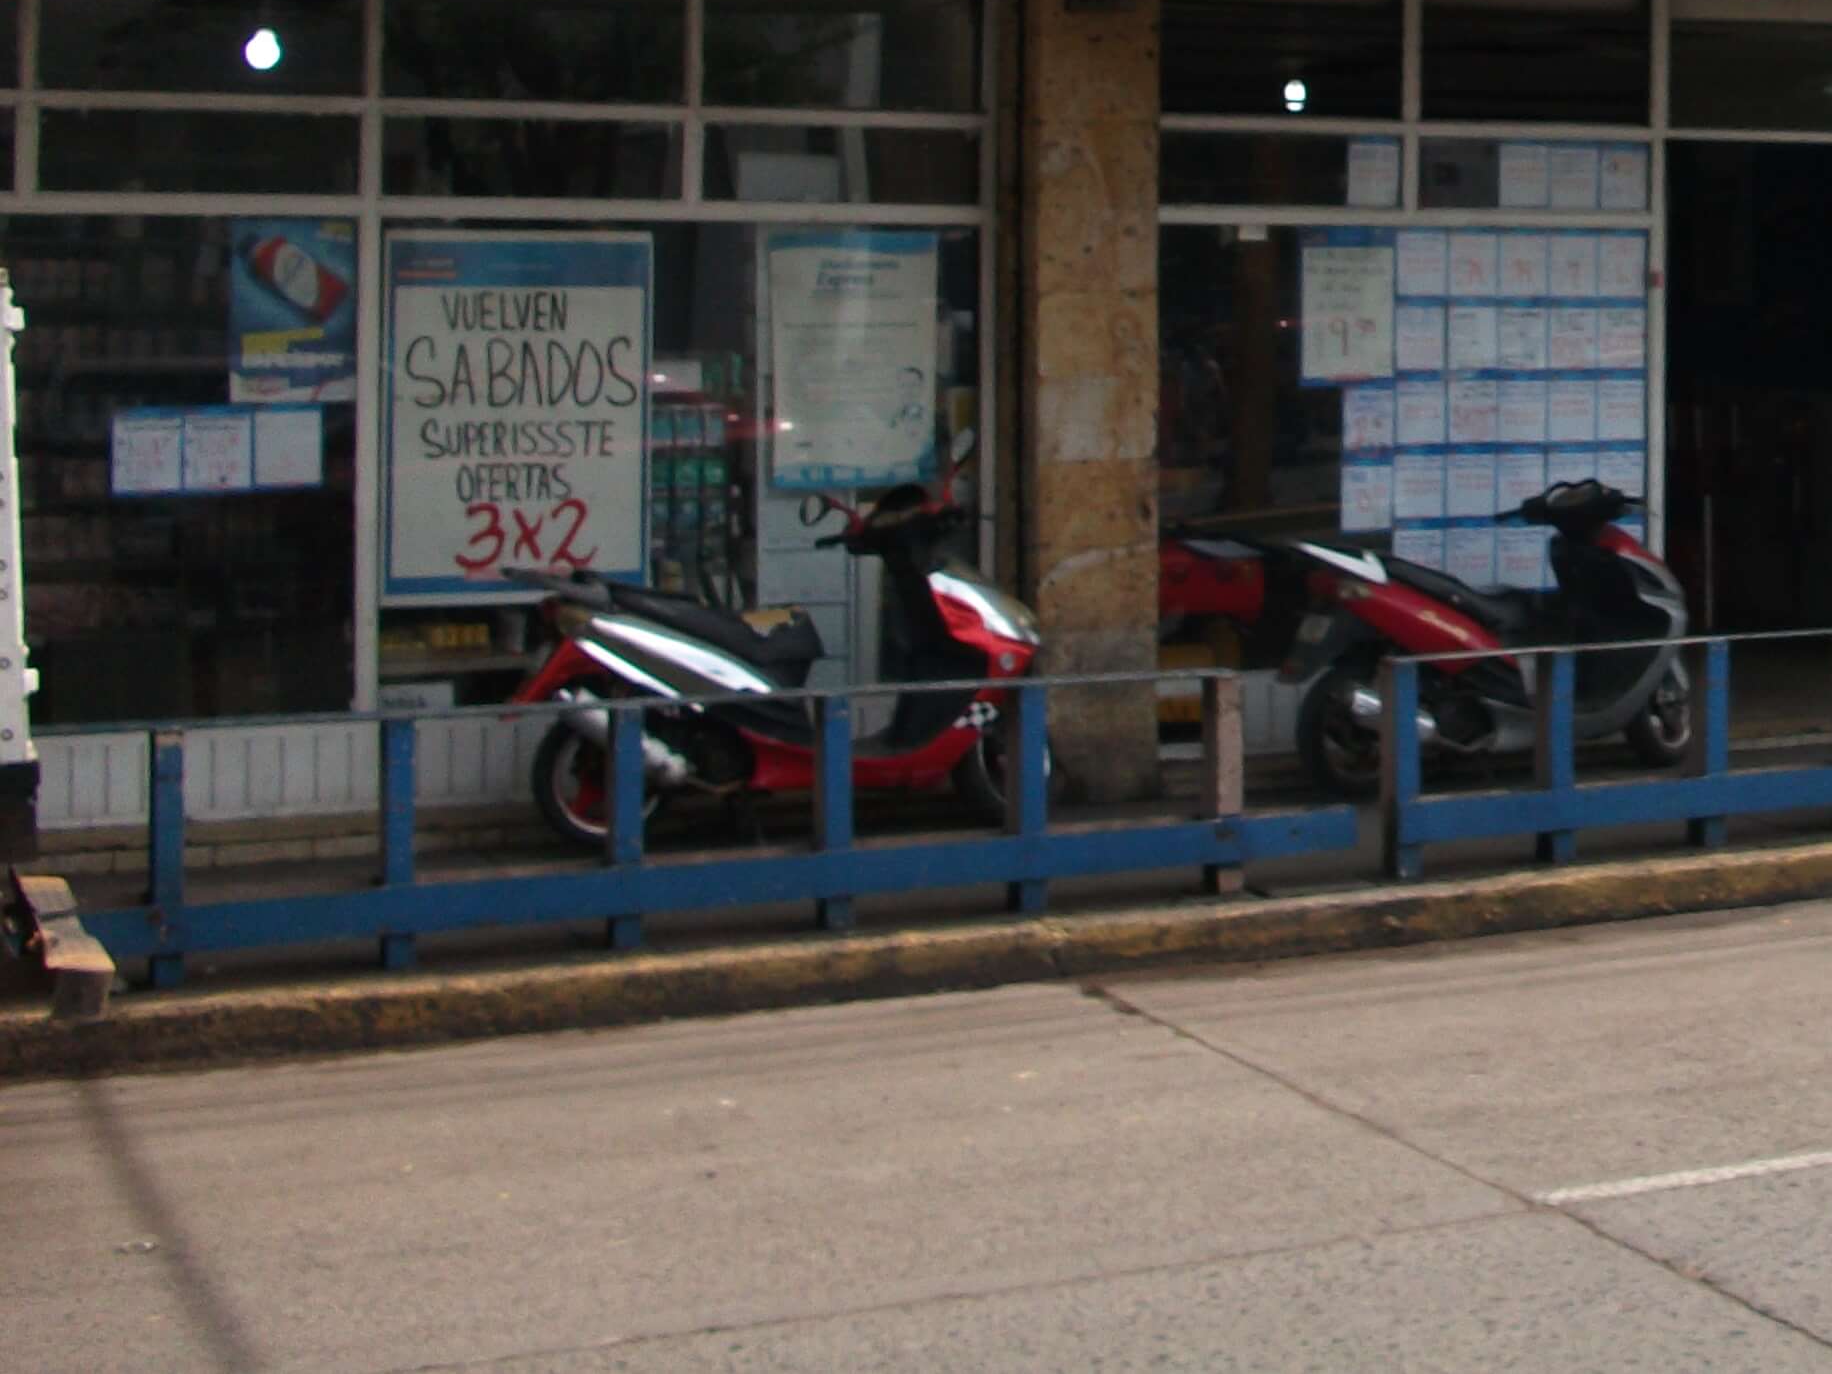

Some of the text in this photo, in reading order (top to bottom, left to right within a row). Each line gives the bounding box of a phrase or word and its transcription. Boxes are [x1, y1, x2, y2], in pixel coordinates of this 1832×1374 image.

[442, 291, 568, 331] VUELVEN
[405, 335, 638, 408] SABADOS
[420, 417, 615, 459] SUPERISSSTE
[456, 463, 572, 503] OFERTAS
